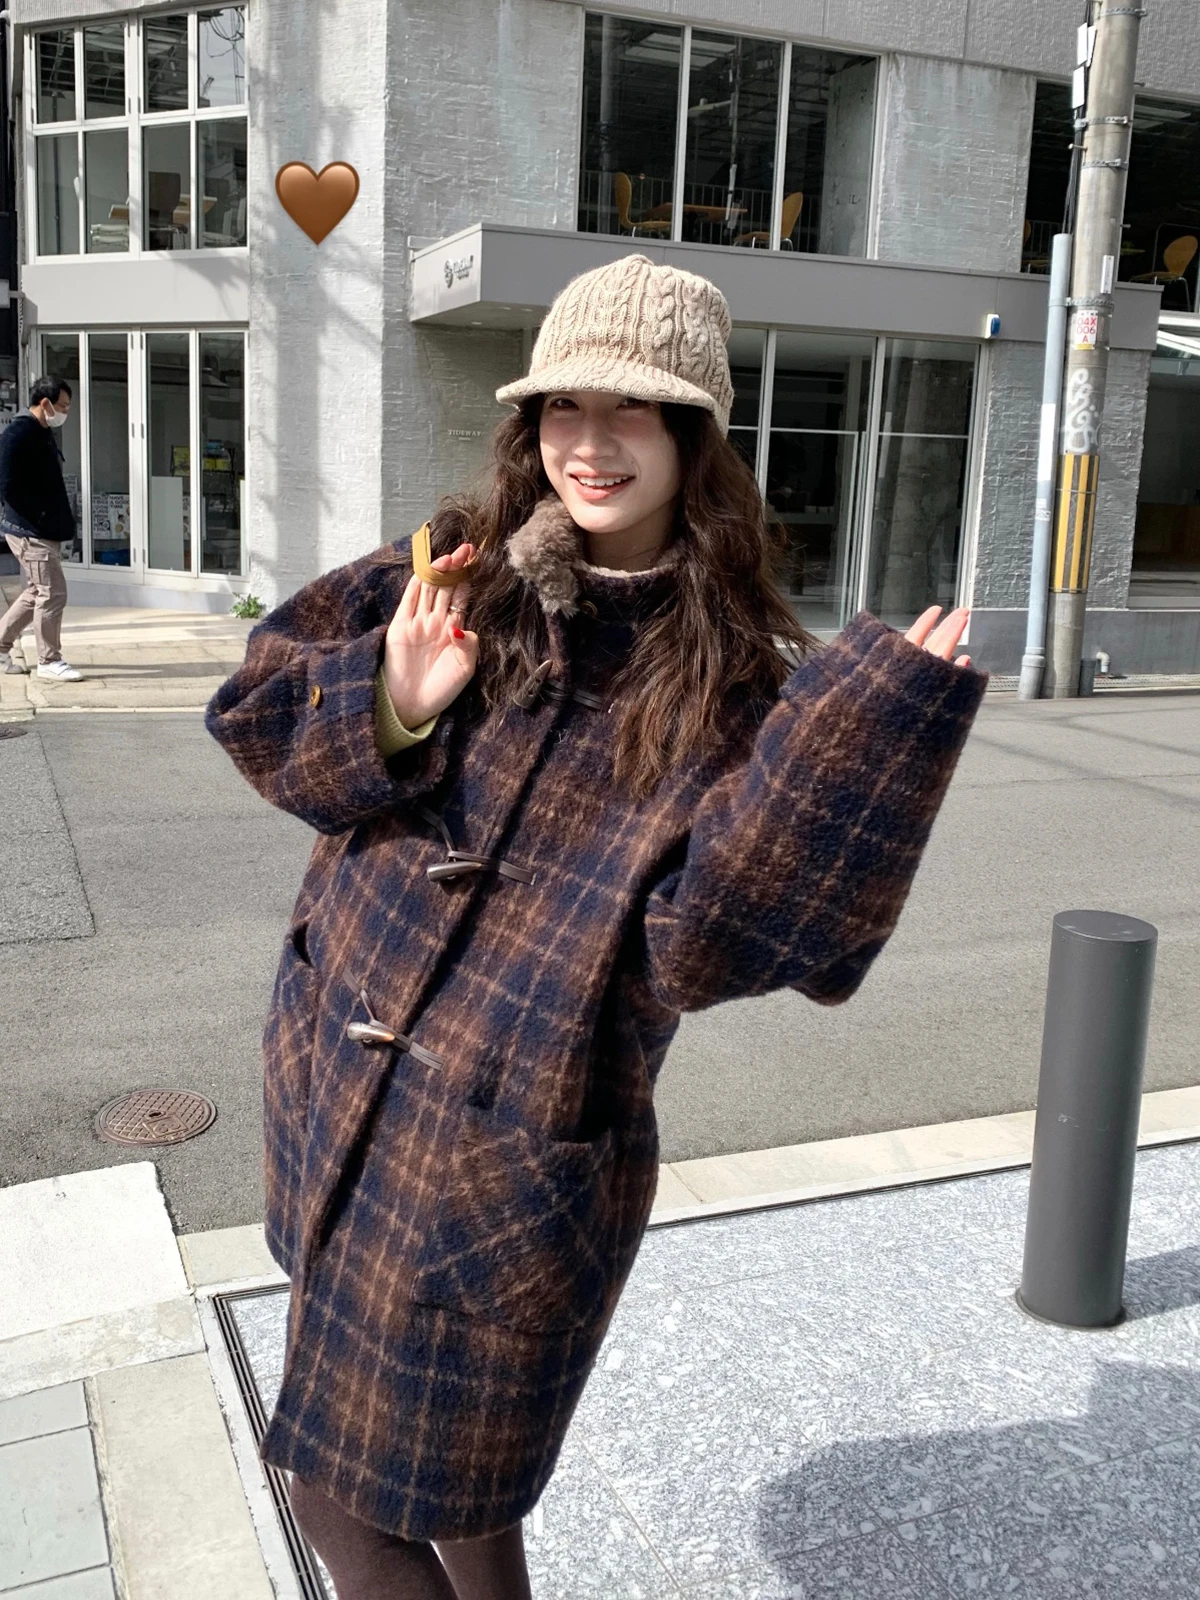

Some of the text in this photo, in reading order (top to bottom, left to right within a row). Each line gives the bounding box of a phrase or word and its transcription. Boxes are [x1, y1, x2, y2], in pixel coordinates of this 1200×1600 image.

[1078, 317, 1097, 326] 04X
[1077, 326, 1096, 335] 006
[1082, 335, 1090, 343] A
